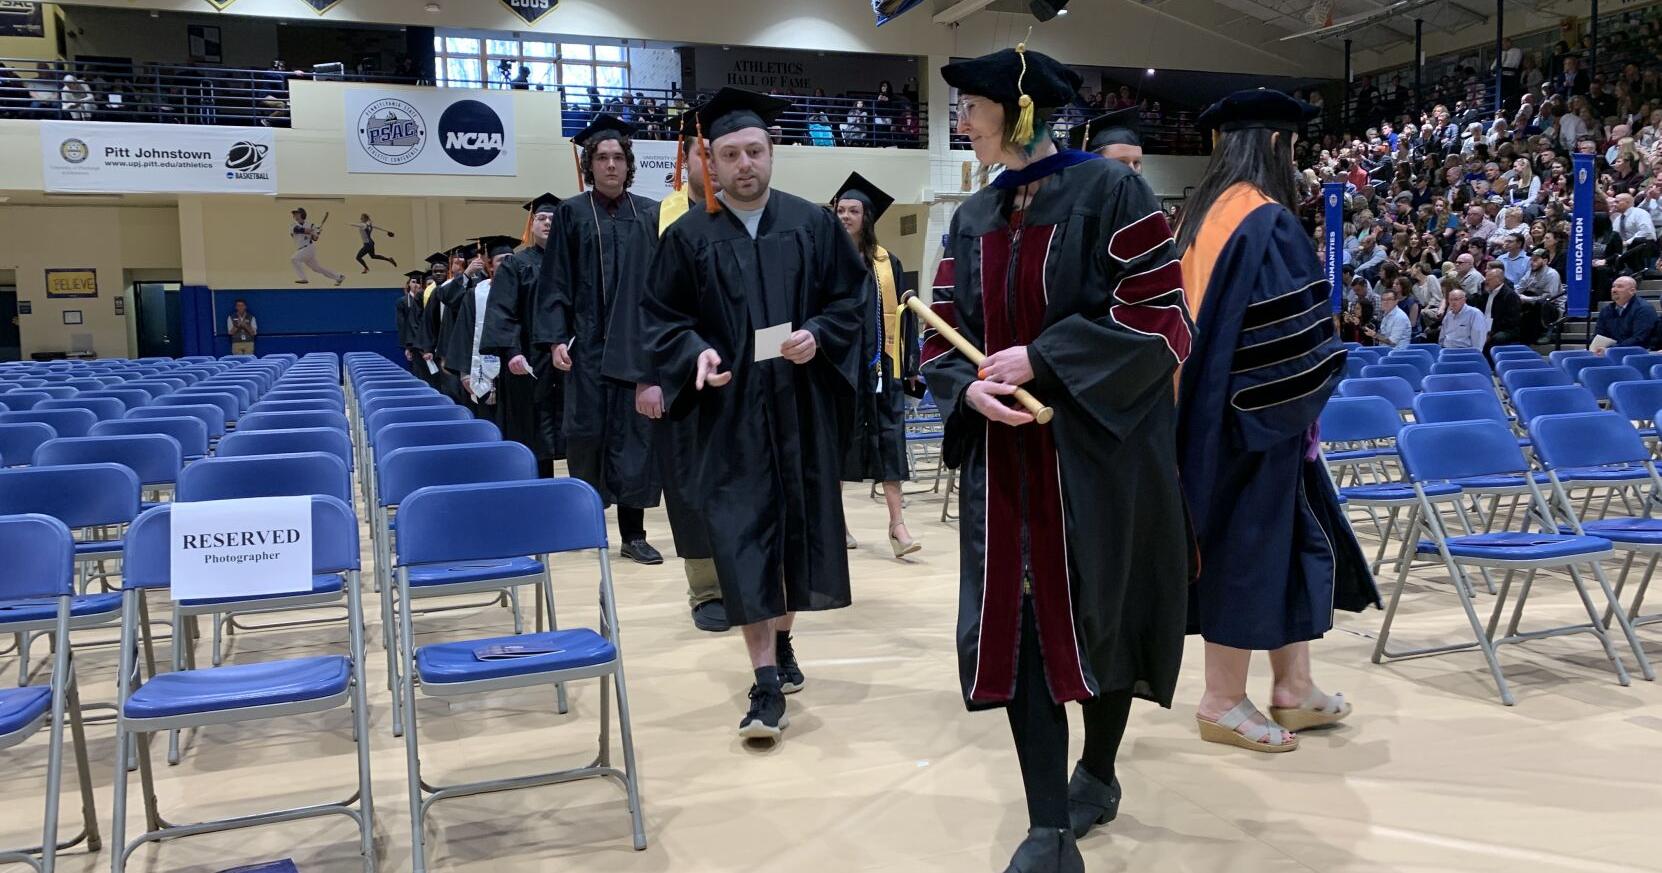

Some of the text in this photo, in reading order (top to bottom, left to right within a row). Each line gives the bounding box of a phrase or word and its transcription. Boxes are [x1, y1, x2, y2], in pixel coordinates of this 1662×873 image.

[734, 60, 803, 75] ATHLETICS
[727, 73, 812, 88] HALL OF FAME
[369, 122, 414, 144] PSAC
[445, 131, 503, 151] NCAA
[104, 147, 212, 160] Pitt Johnstown
[104, 160, 213, 169] www.upj.pitt.edu/athletics
[640, 160, 684, 169] WOMEN
[235, 172, 269, 180] BASKETBALL
[1575, 217, 1584, 281] EDUCATION
[183, 528, 301, 550] RESERVED
[204, 551, 281, 565] Photographer
